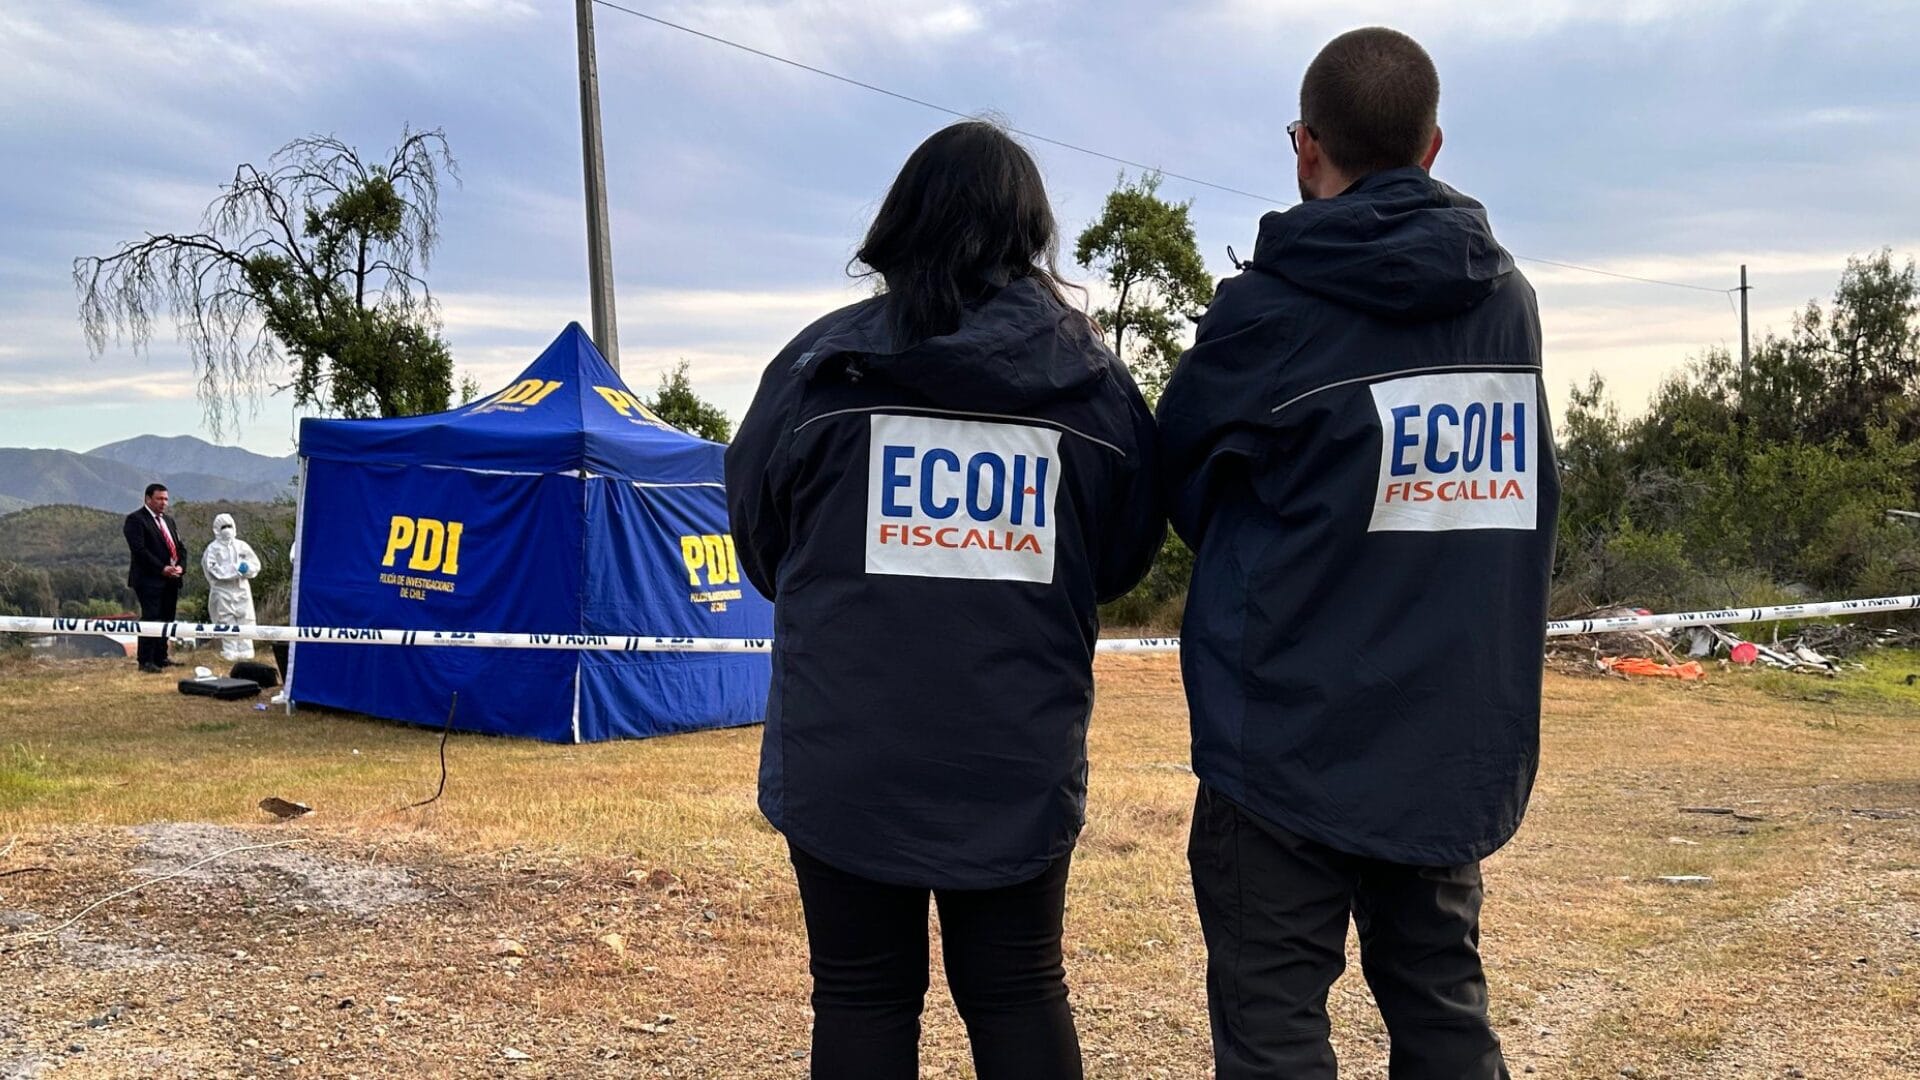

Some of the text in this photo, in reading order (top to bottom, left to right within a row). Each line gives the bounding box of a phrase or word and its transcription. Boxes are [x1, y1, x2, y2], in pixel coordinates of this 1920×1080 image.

[1390, 402, 1526, 477] ECOH
[881, 445, 1049, 528] ECOH
[1384, 479, 1525, 503] FISCALIA
[381, 515, 464, 575] PDI
[680, 533, 741, 586] PDI
[879, 524, 1043, 554] FISCALIA
[396, 575, 405, 586] DE
[405, 576, 455, 593] INVESTIGACIONES
[400, 587, 426, 600] DE CHILE
